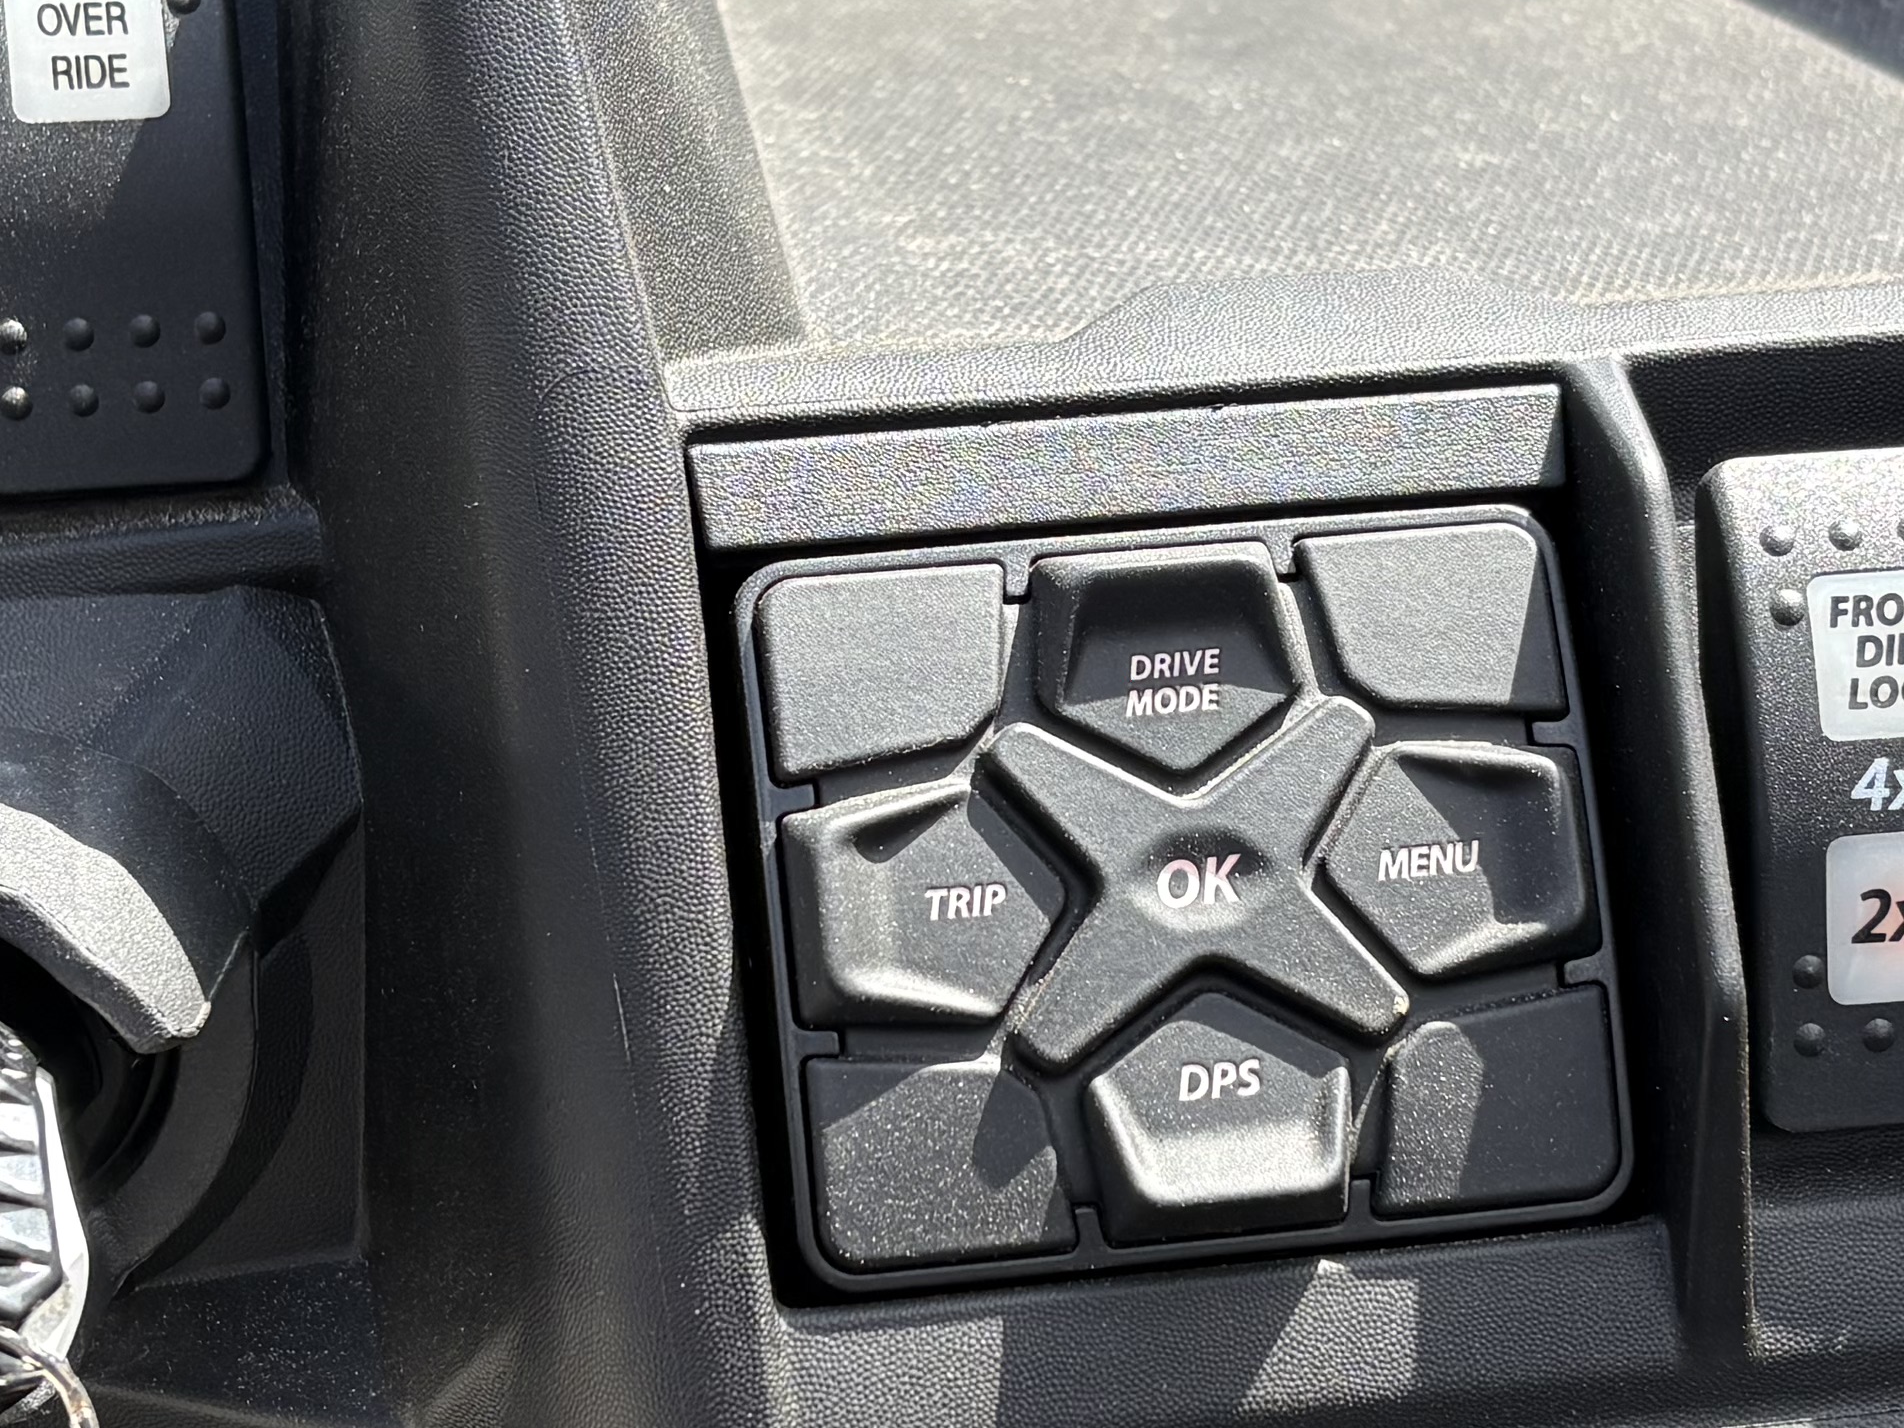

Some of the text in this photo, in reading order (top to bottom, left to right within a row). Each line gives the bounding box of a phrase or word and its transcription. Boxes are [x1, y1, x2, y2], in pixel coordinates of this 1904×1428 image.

[37, 1, 128, 36] OVER
[51, 53, 130, 91] RIDE
[1130, 648, 1221, 681] DRIVE
[1125, 683, 1221, 718] MODE
[1377, 840, 1480, 883] MENU
[1156, 854, 1244, 909] OK
[925, 885, 1007, 922] TRIP
[1179, 1060, 1262, 1102] DPS
